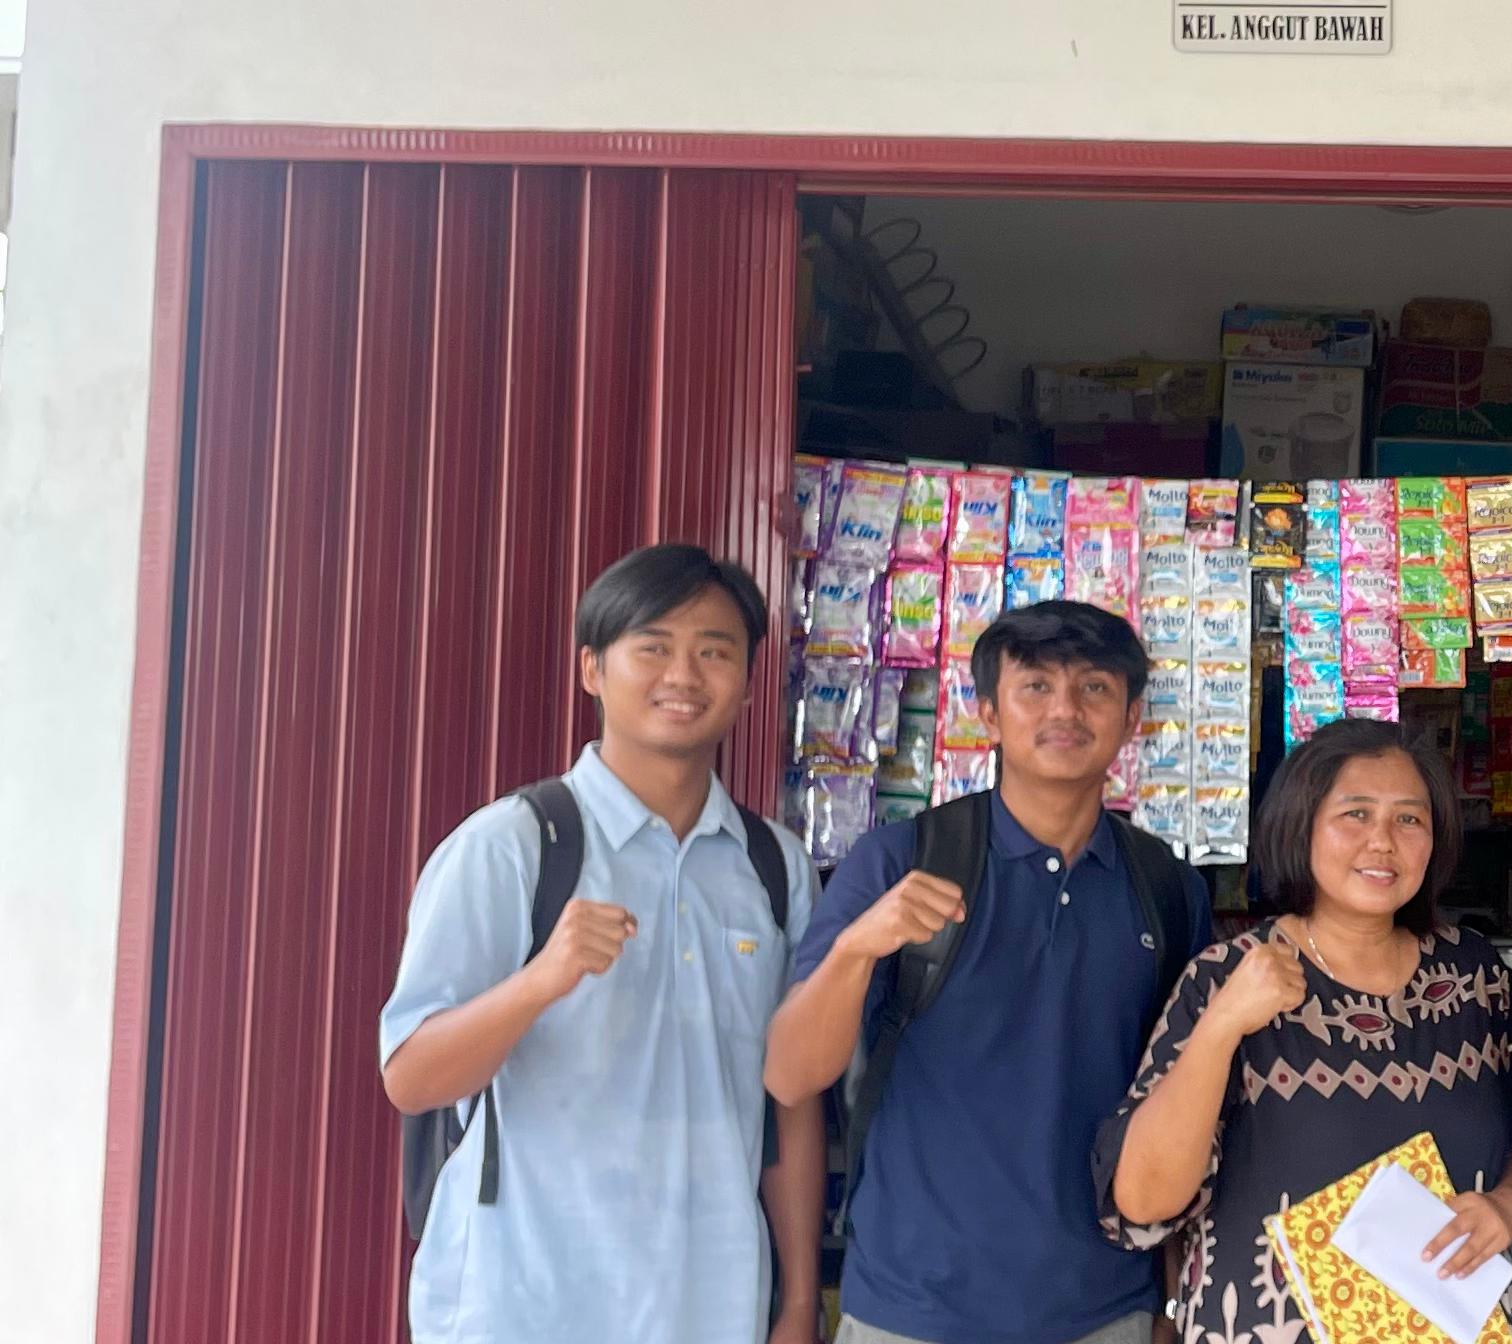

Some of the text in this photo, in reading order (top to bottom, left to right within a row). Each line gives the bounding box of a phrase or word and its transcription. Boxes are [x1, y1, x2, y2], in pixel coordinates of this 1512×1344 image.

[1181, 14, 1384, 42] KEL. ANGGUT BAWAH
[1148, 488, 1188, 503] Molto
[965, 500, 999, 517] Klin
[840, 516, 883, 542] Klin
[1146, 549, 1187, 566] Molto
[1203, 554, 1245, 570] Molto
[1352, 626, 1392, 639] Downy
[1202, 679, 1243, 694] Molto
